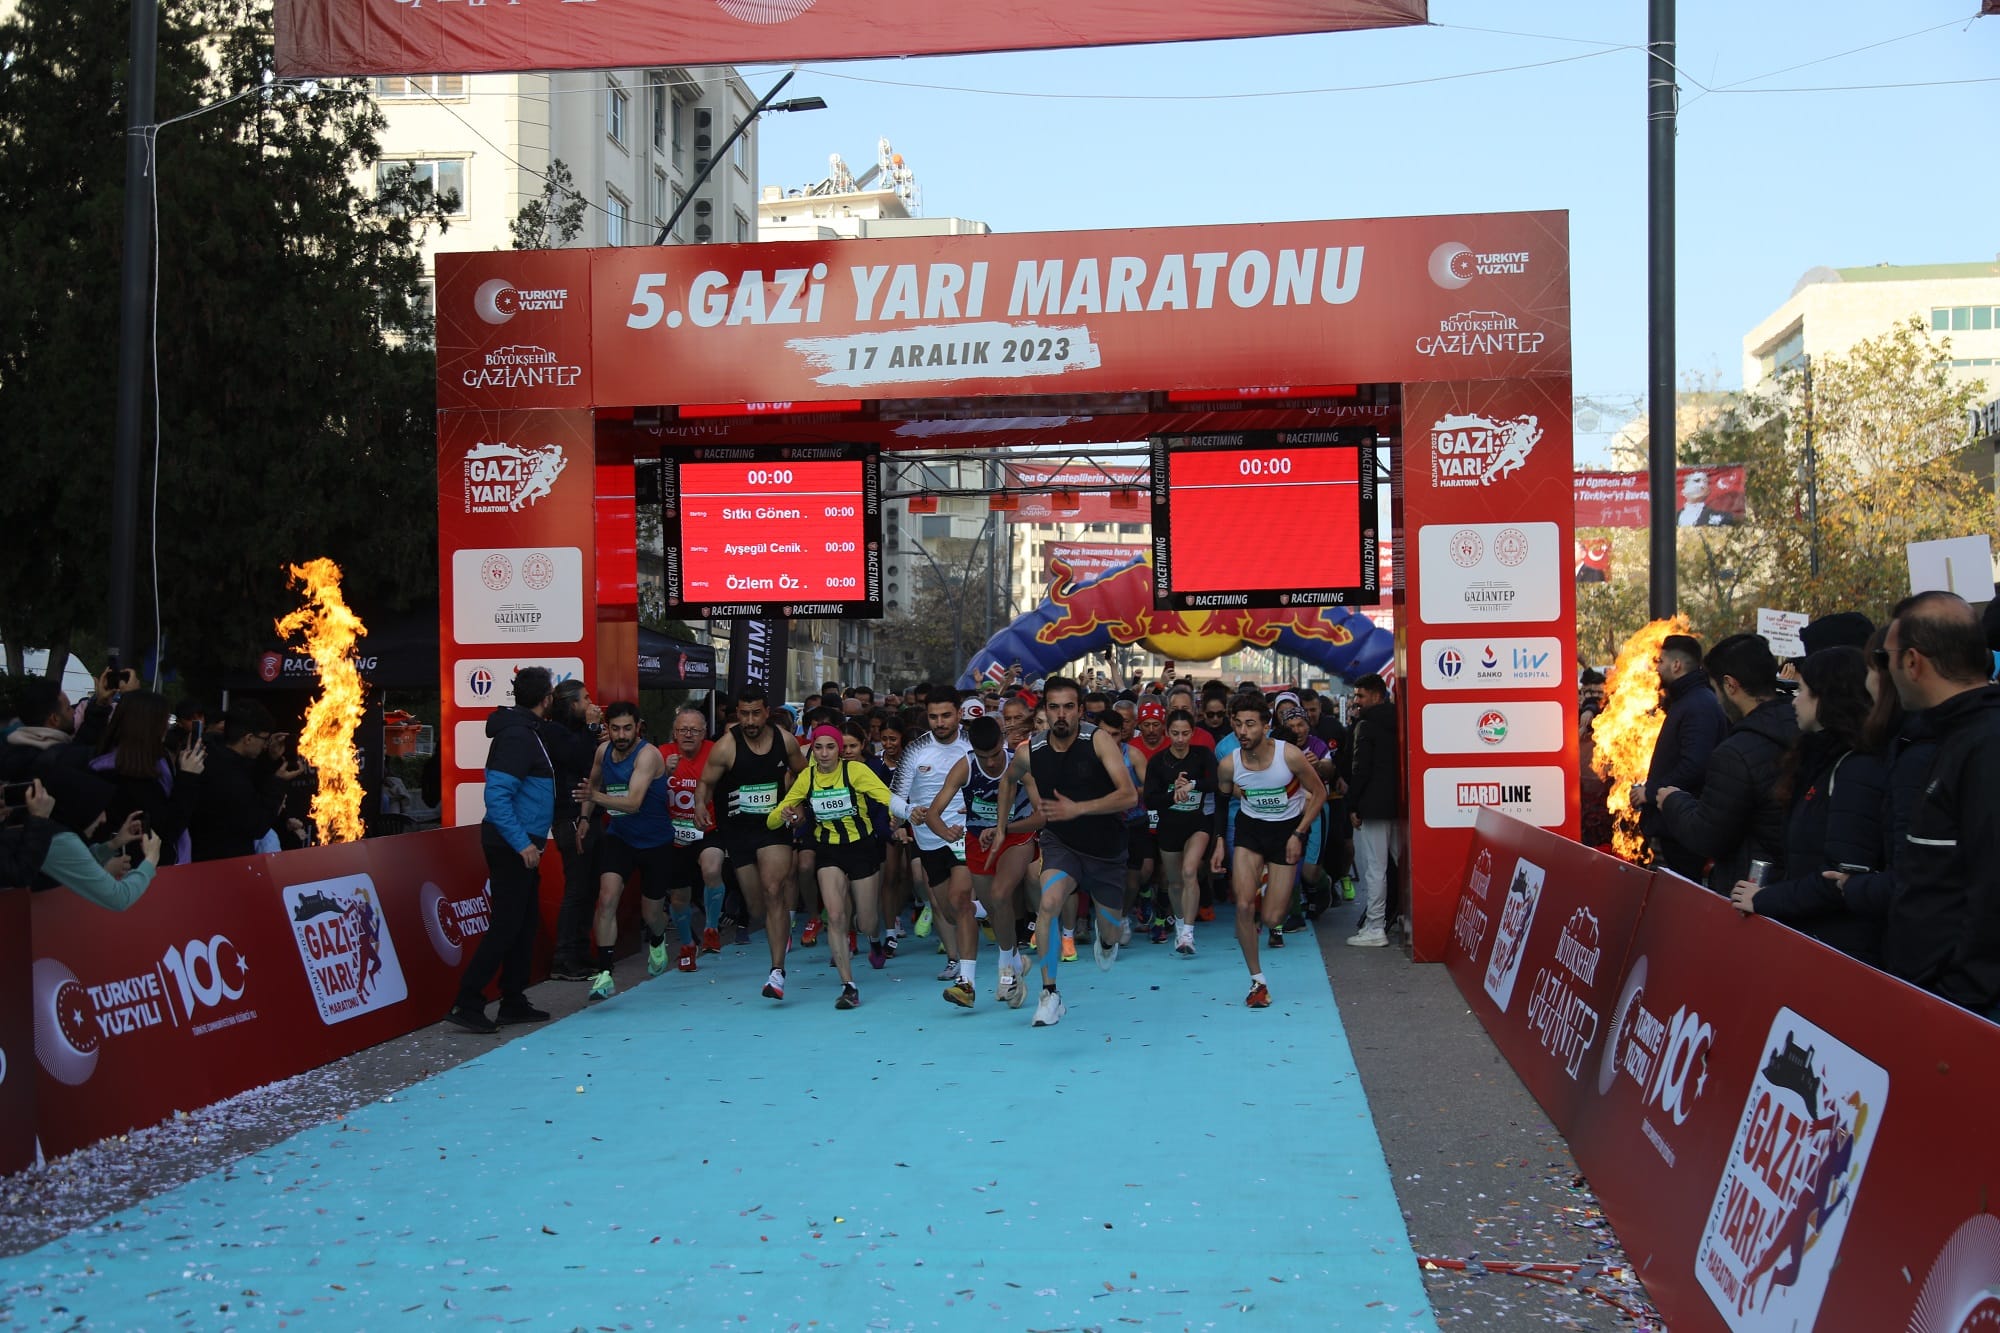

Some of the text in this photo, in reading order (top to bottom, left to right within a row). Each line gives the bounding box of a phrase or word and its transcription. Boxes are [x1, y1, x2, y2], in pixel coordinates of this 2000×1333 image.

[850, 261, 989, 321] YARI
[1007, 246, 1365, 316] MARATONU
[1439, 317, 1520, 333] BÜYÜKŞEHİR
[1415, 331, 1545, 357] GAZİANTEP
[485, 351, 558, 366] BÜYÜKŞEHİR
[848, 337, 1071, 371] 17 ARALIK 2023
[462, 365, 582, 389] GAZİANTEP
[1191, 435, 1243, 447] RACETIMING
[1286, 432, 1339, 444] RACETIMING
[704, 448, 755, 459] RACETIMING
[791, 448, 842, 459] RACETIMING
[1239, 457, 1292, 476] 00:00
[1362, 447, 1373, 500] RACETIMING
[1438, 457, 1482, 477] YARI
[666, 457, 675, 510] RACETIMING
[747, 470, 793, 485] 00:00
[1440, 479, 1479, 487] MARATONU
[471, 485, 511, 503] YARI
[866, 462, 878, 515] RACETIMING
[472, 505, 509, 513] MARATONU
[722, 508, 752, 519] Sıtkı
[755, 507, 801, 519] Gönen
[824, 507, 855, 518] 00:00
[724, 543, 767, 555] Ayşegül
[769, 543, 801, 553] Cenik
[825, 542, 855, 552] 00:00
[1157, 537, 1168, 590] RACETIMING
[1364, 538, 1375, 591] RACETIMING
[669, 546, 678, 598] RACETIMING
[867, 550, 879, 602] RACETIMING
[726, 574, 773, 590] Özlem
[779, 574, 799, 590] Öz
[826, 577, 856, 588] 00:00
[1195, 594, 1248, 606] RACETIMING
[1291, 592, 1344, 604] RACETIMING
[1464, 588, 1515, 602] GAZİANTEP
[494, 610, 542, 624] GAZİANTEP
[711, 605, 762, 616] RACETIMING
[792, 604, 844, 615] RACETIMING
[1512, 648, 1549, 670] liv
[1477, 671, 1503, 679] SANKO
[747, 794, 771, 804] 1819
[1256, 797, 1280, 806] 1886
[1458, 784, 1532, 805] HARD LINE
[820, 799, 844, 810] 1689
[677, 830, 697, 840] 1583
[316, 961, 355, 997] YARI
[328, 997, 360, 1015] MARATONU
[1720, 1174, 1767, 1269] YARI
[1705, 1247, 1740, 1304] MARATONU
